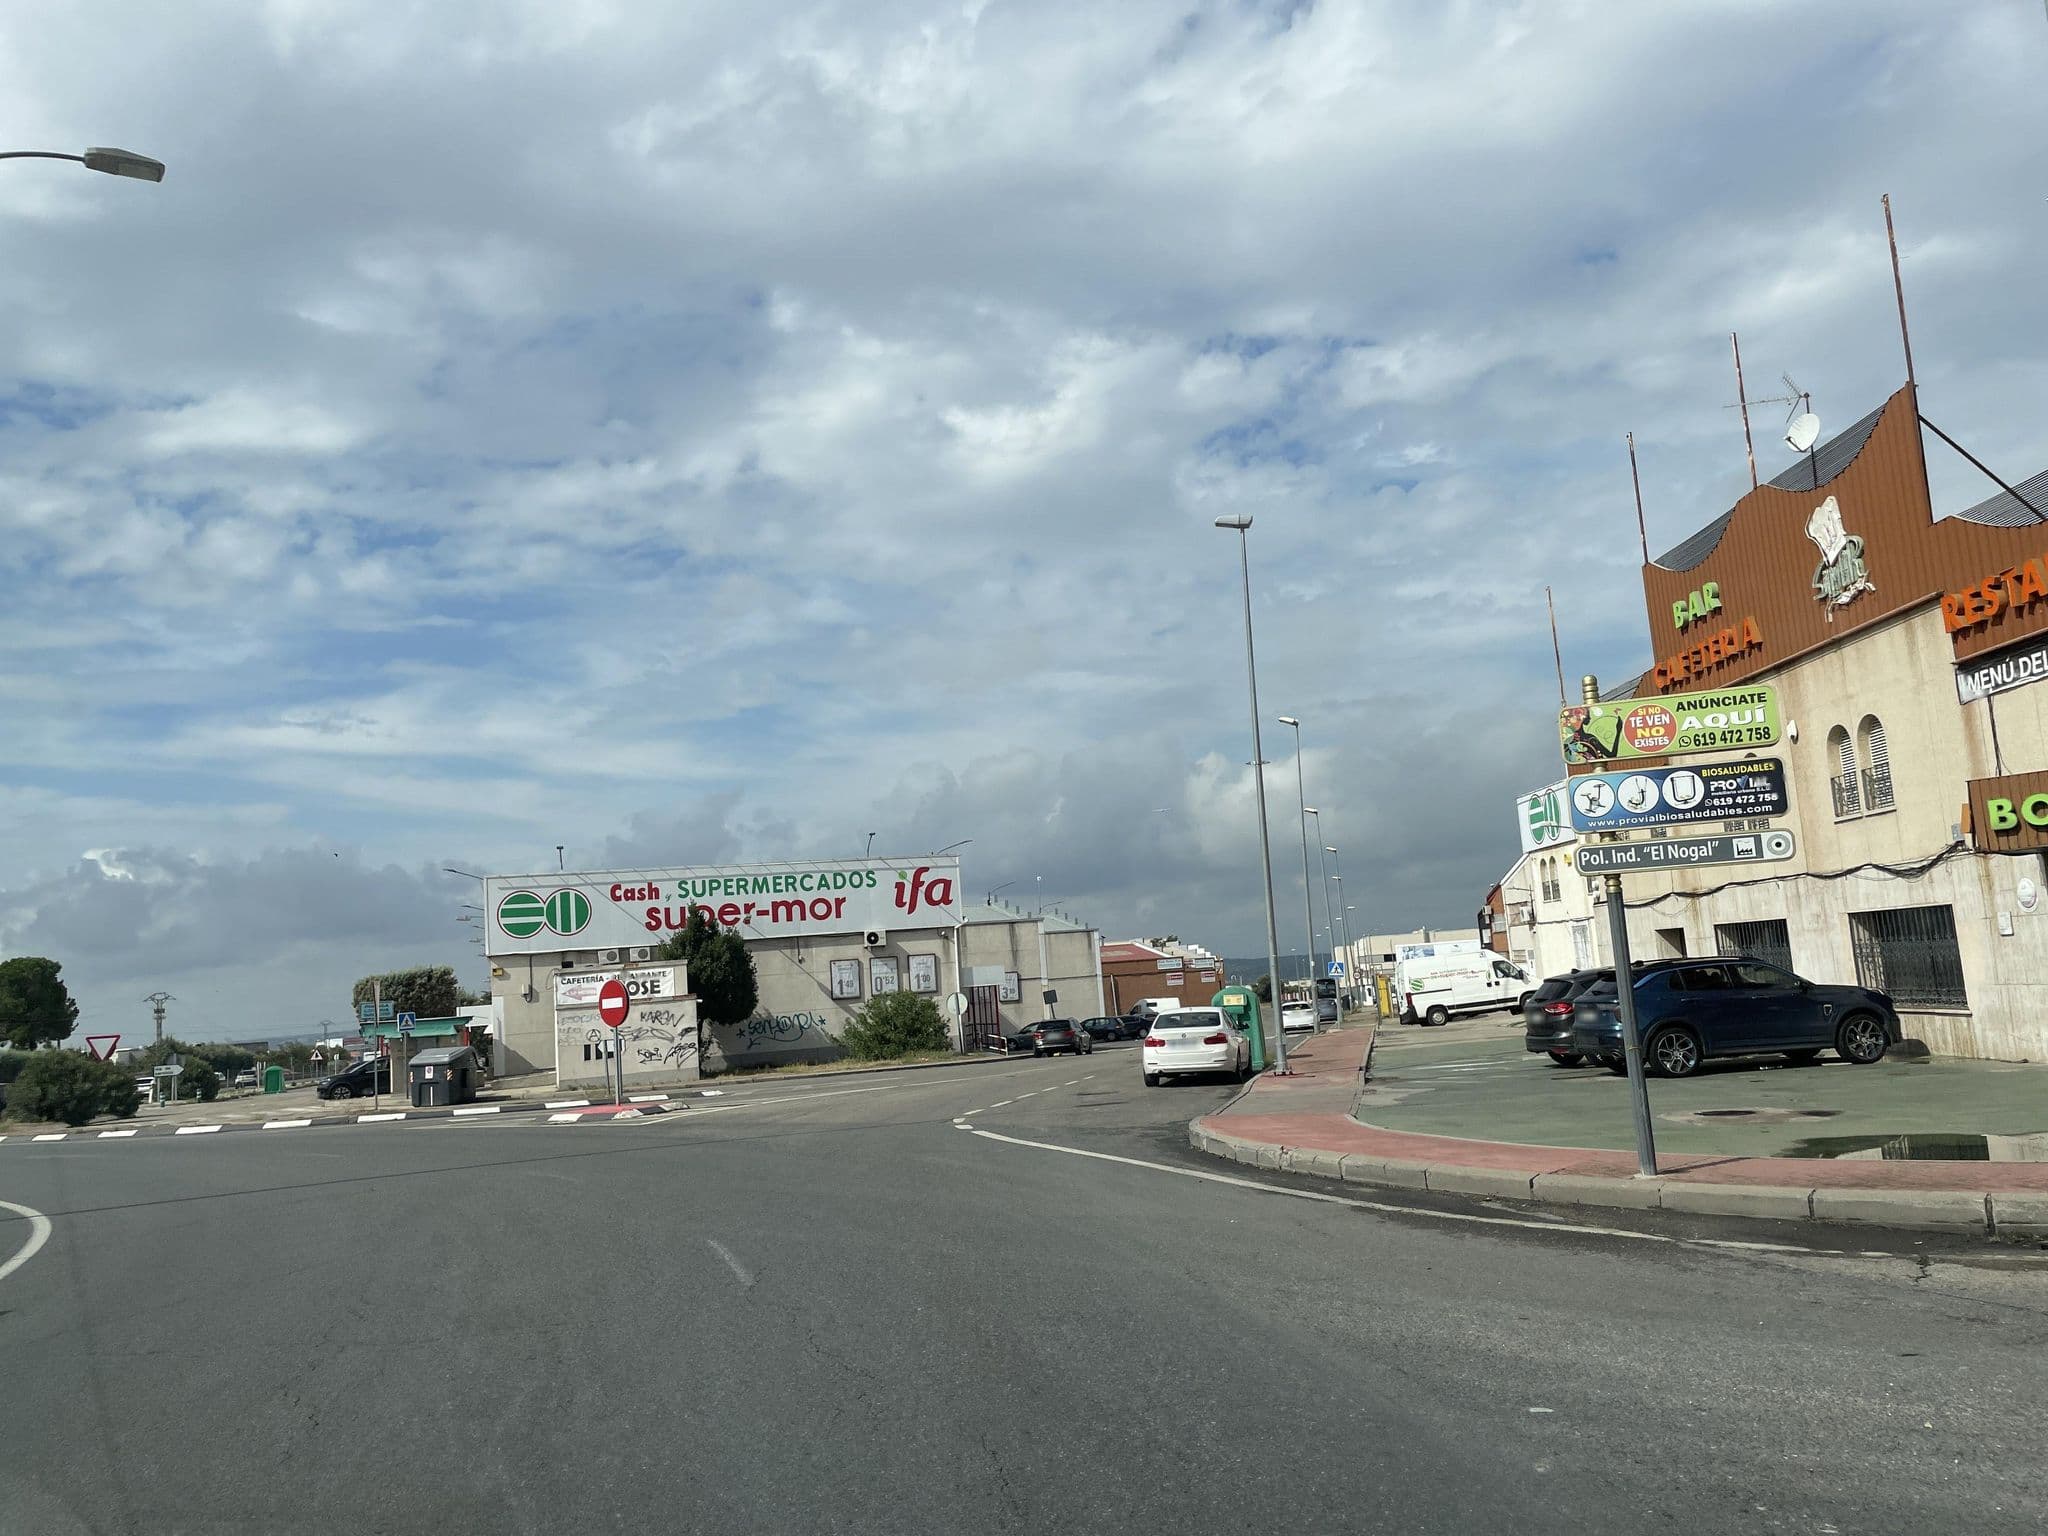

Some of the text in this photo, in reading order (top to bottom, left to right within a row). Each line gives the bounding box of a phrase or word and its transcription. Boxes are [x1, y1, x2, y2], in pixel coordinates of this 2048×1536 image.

[1942, 552, 2048, 632] RESTA
[1673, 581, 1722, 630] BAR
[1654, 616, 1763, 690] CAFETERIA
[1967, 650, 2048, 692] MENÚ DEL
[1637, 706, 1661, 716] SI NO
[1676, 692, 1767, 712] ANÚNCIATE
[1630, 713, 1670, 728] TE VEN
[1681, 704, 1766, 732] AQUÍ
[1634, 736, 1670, 748] EXISTES
[1637, 726, 1666, 738] NO
[1693, 726, 1771, 747] 619 472 758
[1701, 762, 1776, 777] BIOSALUDABLES
[1713, 797, 1733, 806] 619
[1735, 794, 1756, 804] 472
[1587, 805, 1773, 828] www.provialbiosaludables.com
[1580, 850, 1609, 866] Pol.
[1612, 847, 1641, 863] Ind.
[610, 881, 660, 902] Cash
[677, 870, 877, 899] SUPERMERCADOS
[894, 866, 954, 915] ifa
[561, 975, 604, 985] CAFETERÍA
[624, 979, 661, 997] OSE
